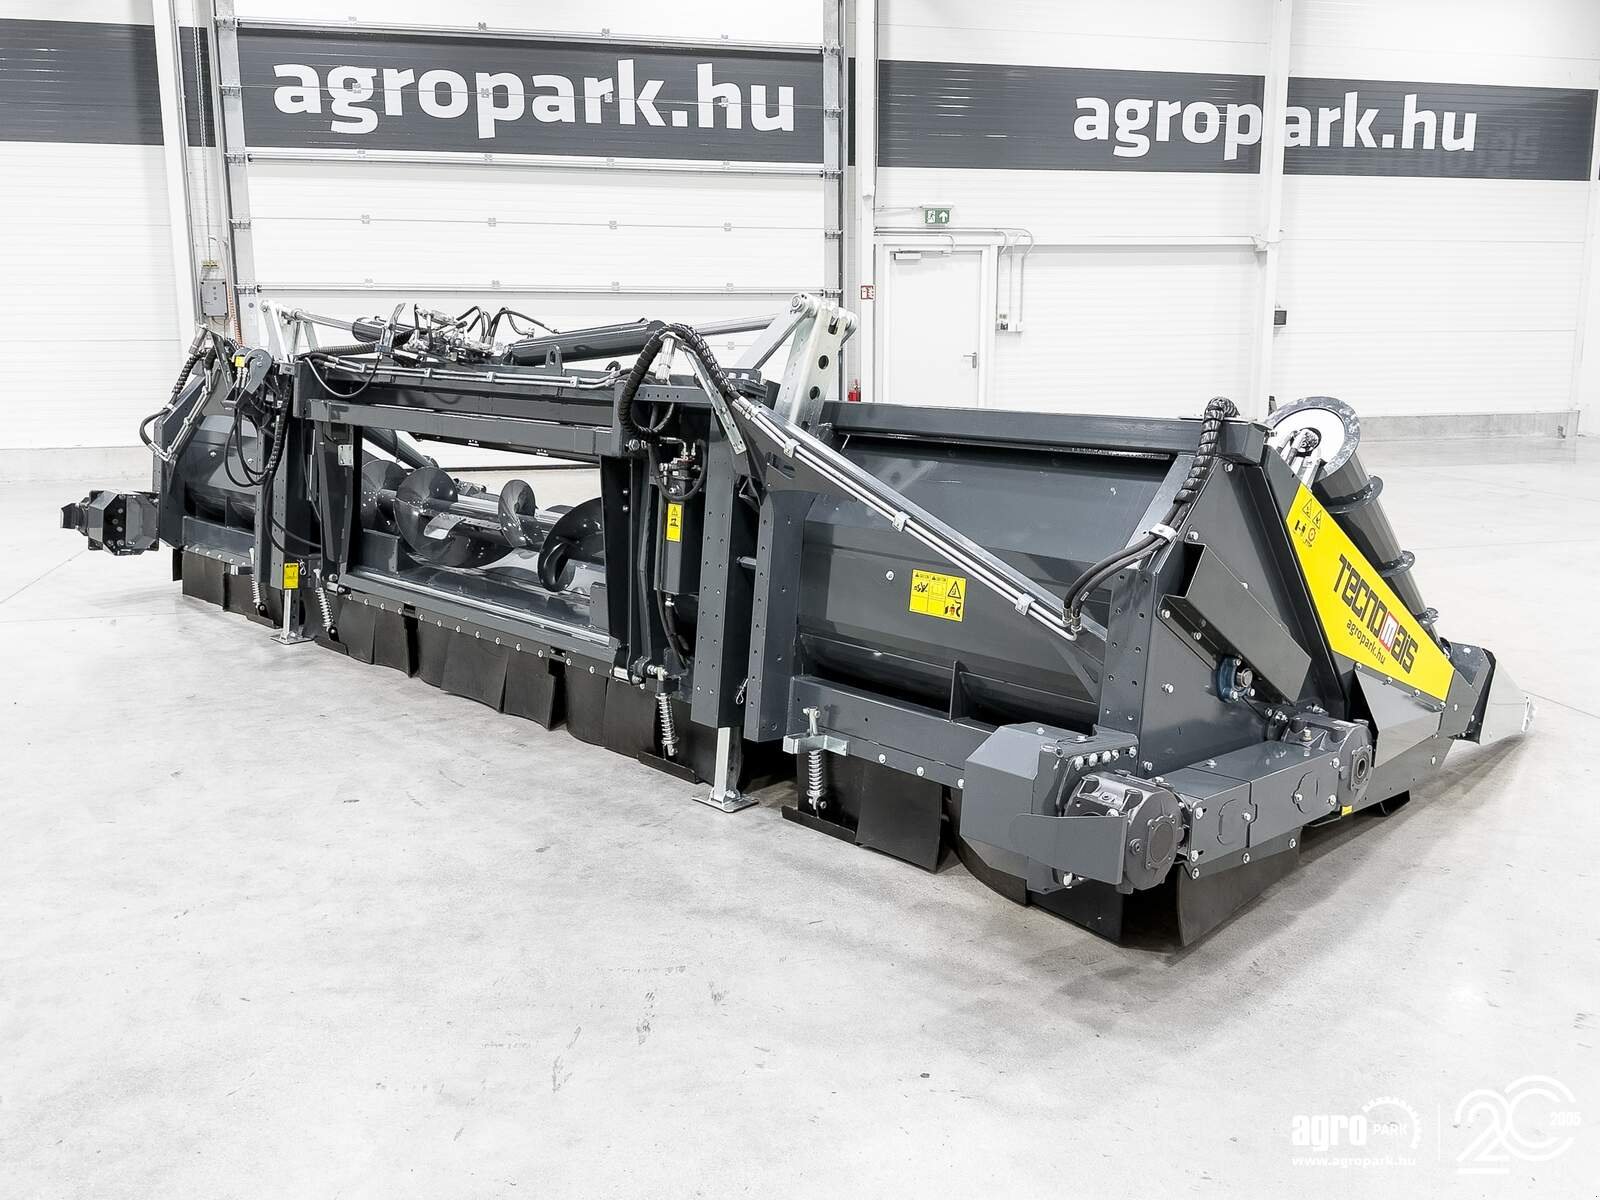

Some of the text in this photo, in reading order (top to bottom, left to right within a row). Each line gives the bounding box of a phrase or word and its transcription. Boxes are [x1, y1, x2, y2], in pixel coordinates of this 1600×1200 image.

[273, 59, 794, 139] agropark.hu
[1073, 91, 1477, 161] agropark.hu
[1347, 619, 1386, 665] agropark.hu
